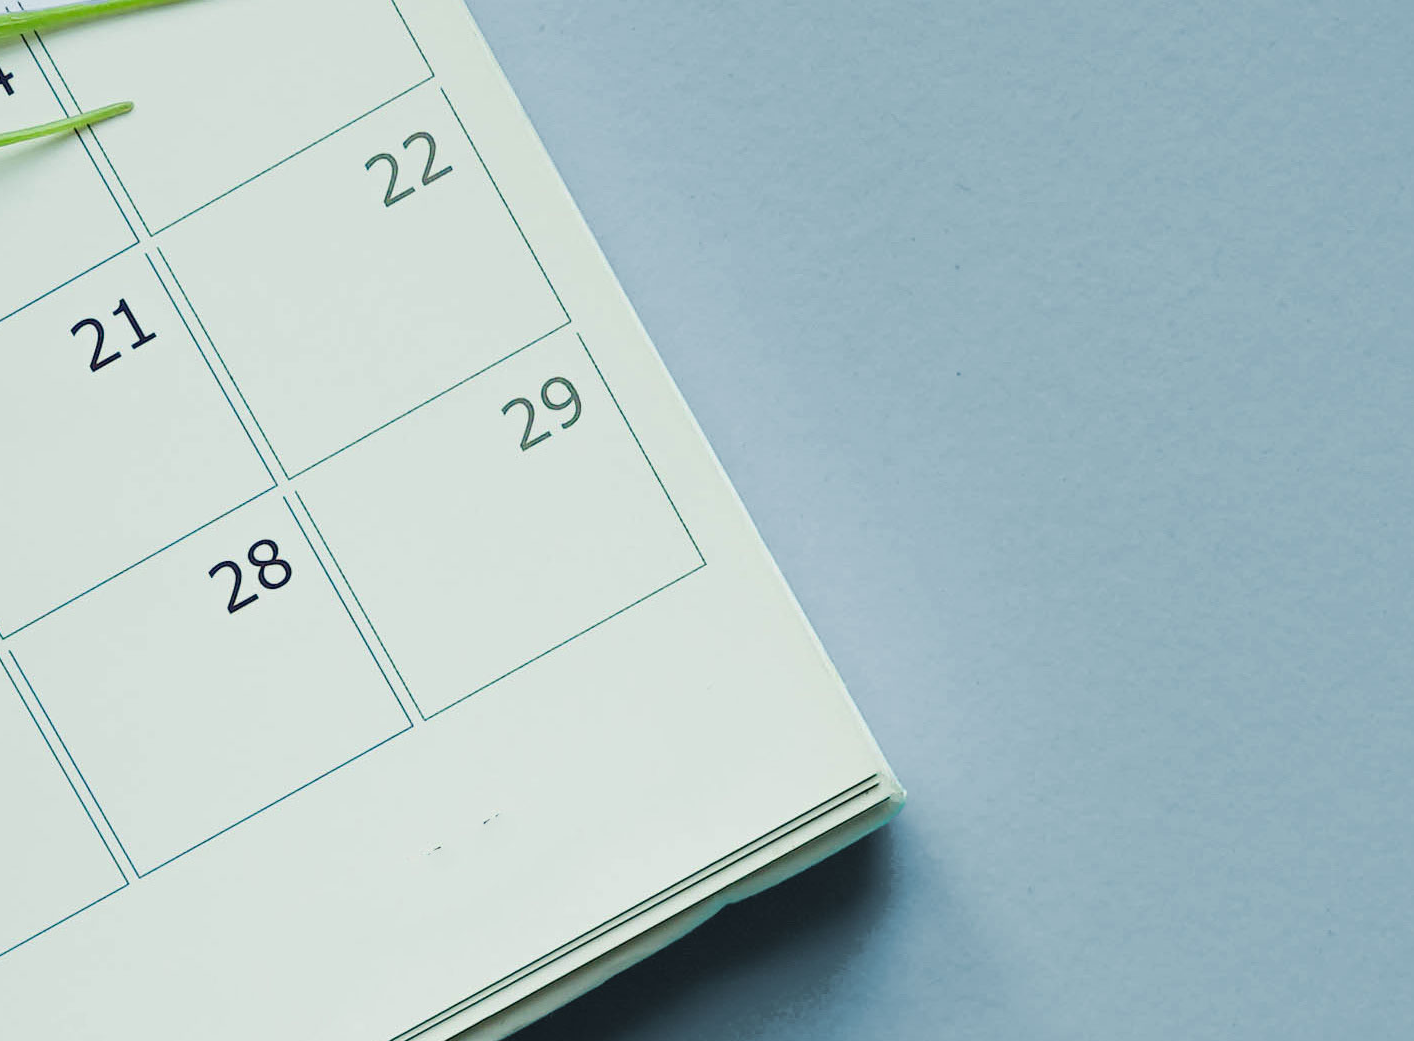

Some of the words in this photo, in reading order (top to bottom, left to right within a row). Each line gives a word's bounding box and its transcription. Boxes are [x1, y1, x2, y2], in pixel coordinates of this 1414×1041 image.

[364, 131, 454, 208] 22
[70, 298, 157, 373] 21
[501, 376, 582, 452] 29
[208, 539, 292, 615] 28
